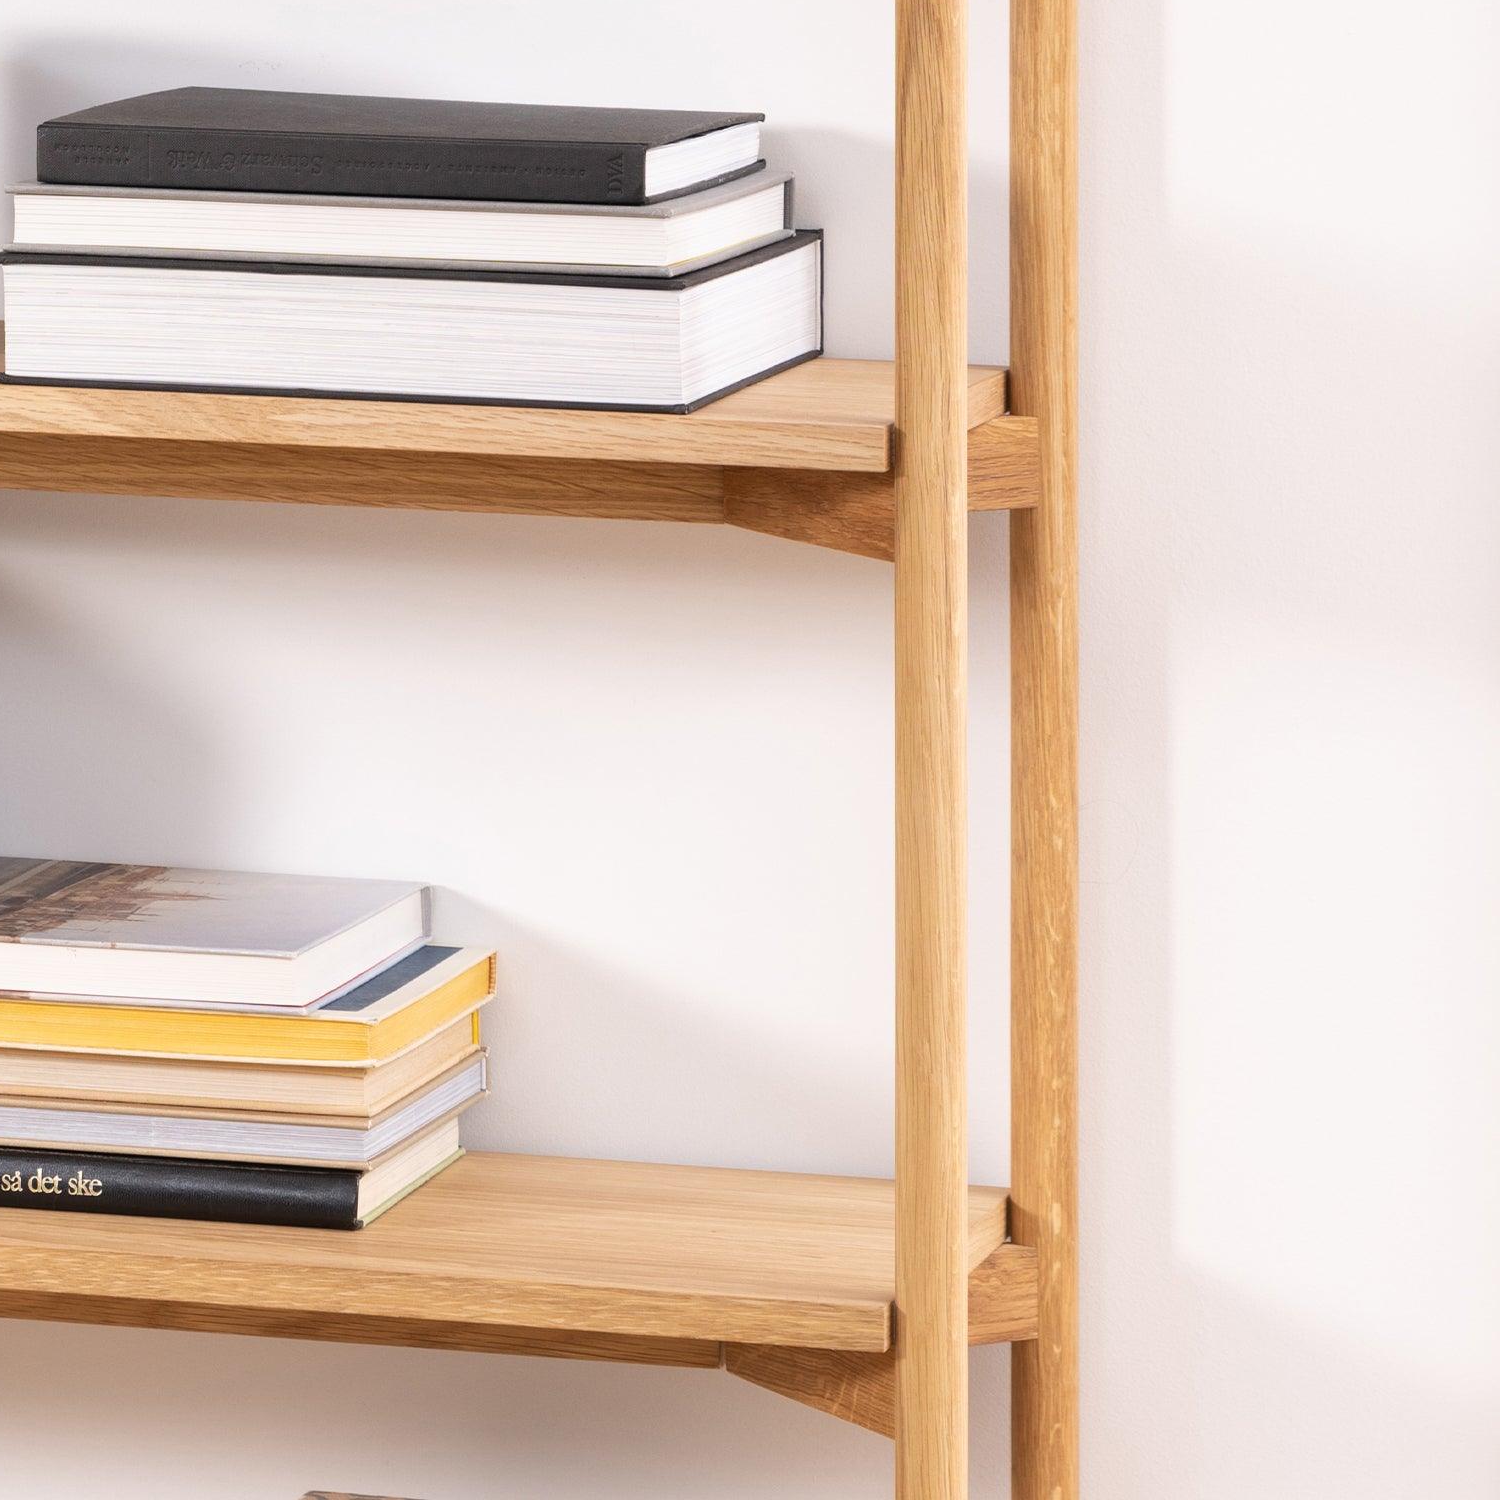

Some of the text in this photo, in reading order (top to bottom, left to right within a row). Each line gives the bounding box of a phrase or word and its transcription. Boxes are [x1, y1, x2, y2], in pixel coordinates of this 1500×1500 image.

[1, 1168, 23, 1193] så
[27, 1168, 62, 1195] det
[68, 1170, 103, 1197] ske
